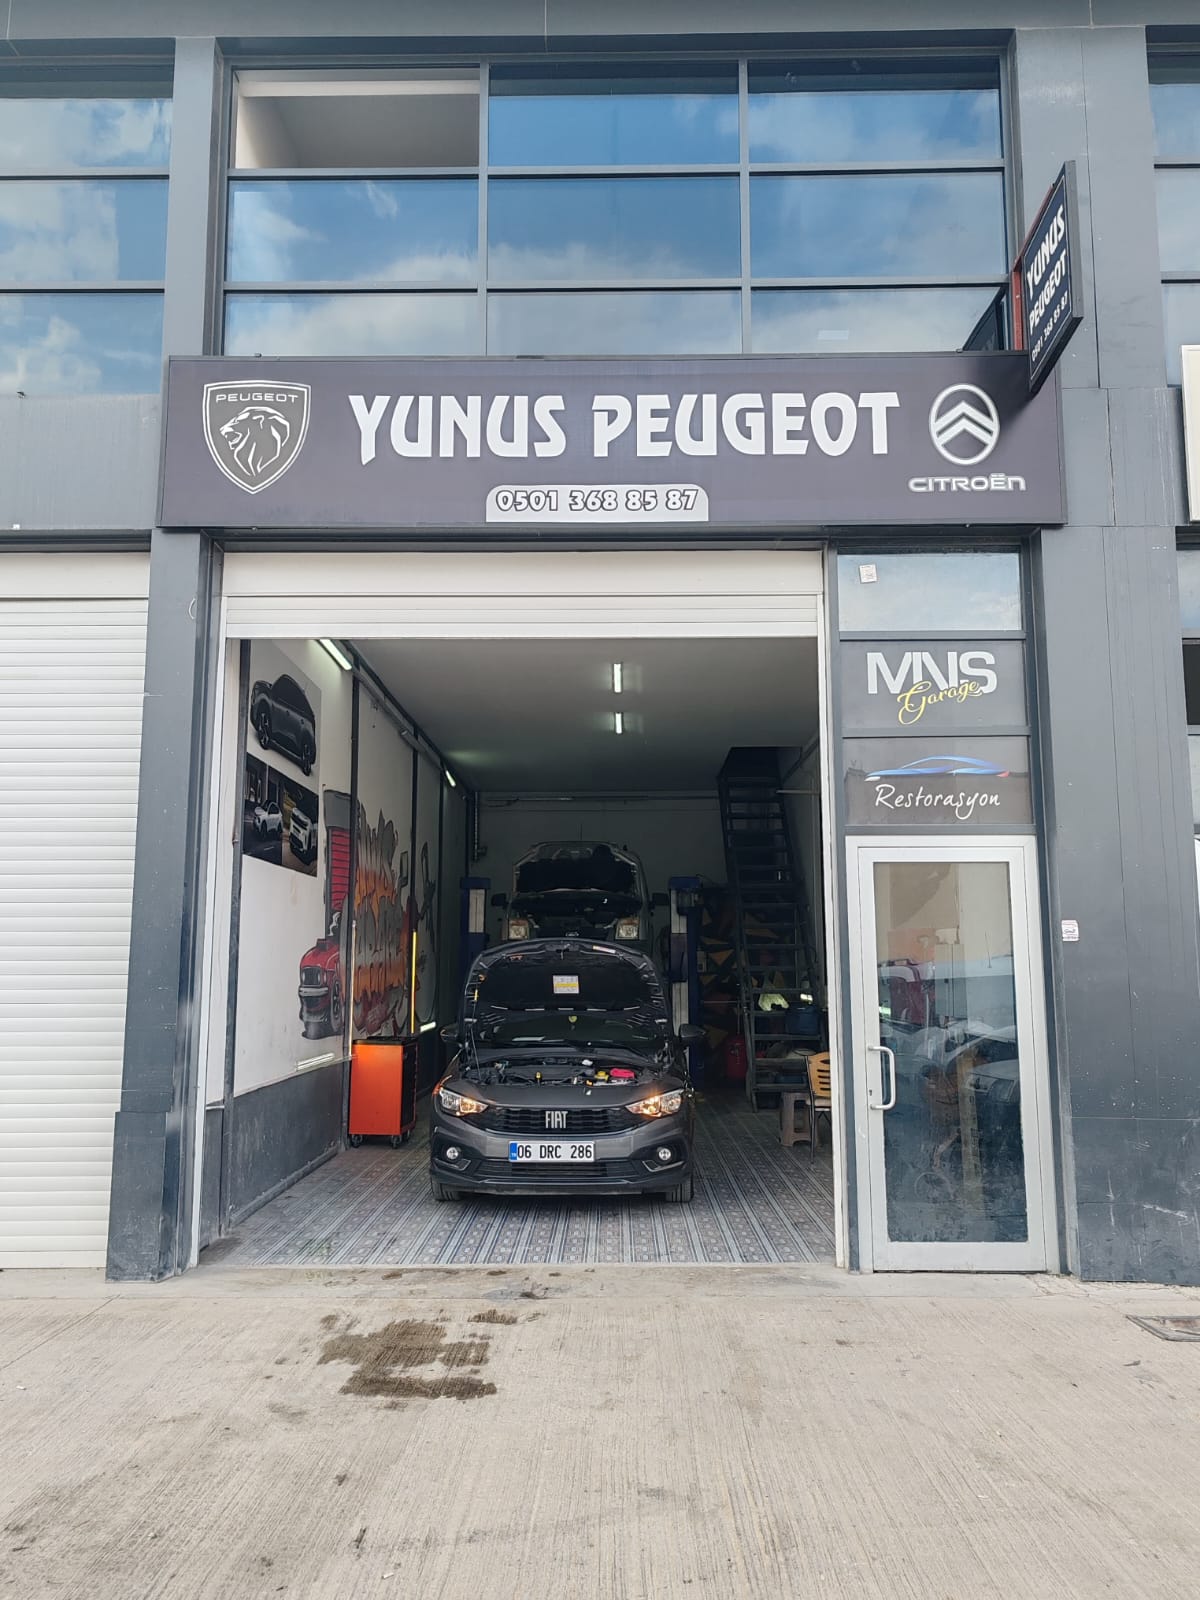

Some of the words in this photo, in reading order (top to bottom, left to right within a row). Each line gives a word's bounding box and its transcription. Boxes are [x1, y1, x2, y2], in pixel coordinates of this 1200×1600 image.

[1026, 204, 1065, 299] YUNUS
[1029, 248, 1067, 336] PEUGEOT
[215, 393, 299, 404] PEUGEOT
[348, 394, 567, 466] YUNUS
[591, 391, 900, 457] PEUGEOT
[495, 490, 558, 511] 0501
[569, 490, 618, 511] 368
[625, 490, 657, 511] 85
[665, 489, 698, 510] 87
[866, 651, 998, 695] MNS
[897, 680, 983, 725] Garage
[875, 784, 1000, 820] Restorasyon
[545, 1110, 568, 1129] FIAT
[517, 1144, 531, 1159] 06
[540, 1144, 562, 1159] DRC
[570, 1144, 593, 1159] 286
